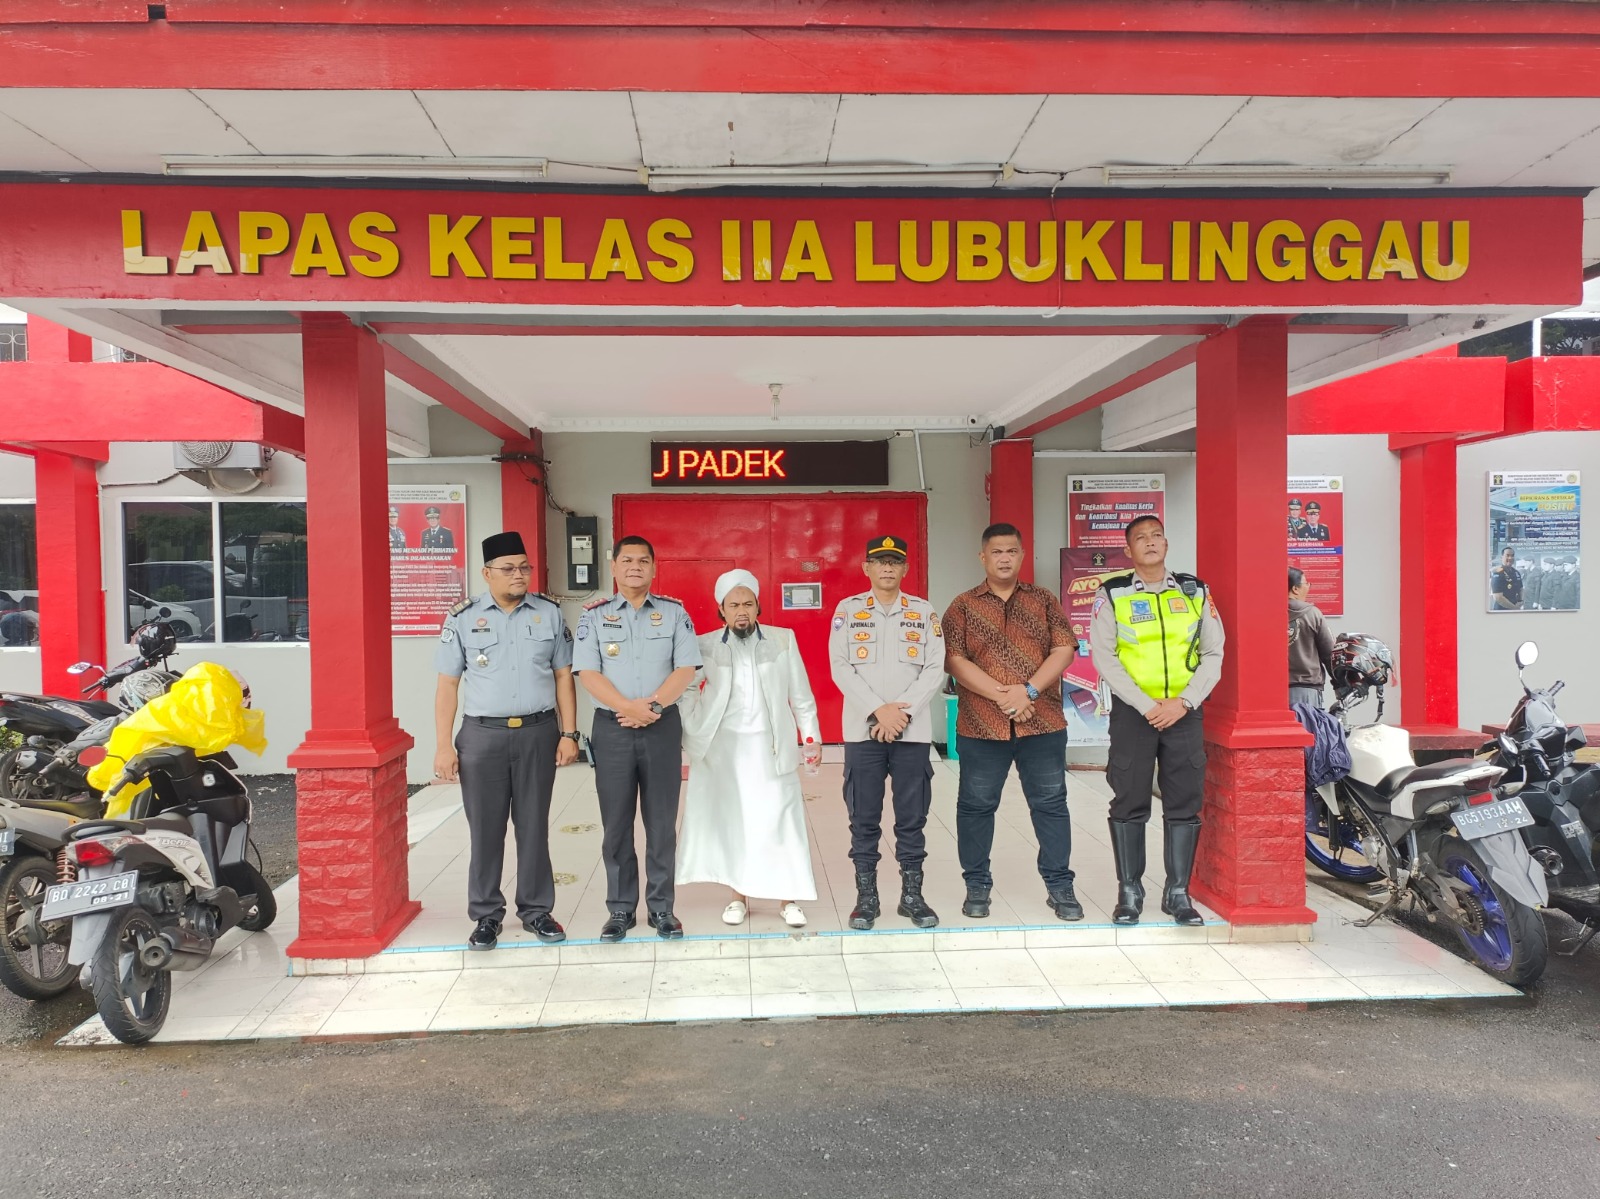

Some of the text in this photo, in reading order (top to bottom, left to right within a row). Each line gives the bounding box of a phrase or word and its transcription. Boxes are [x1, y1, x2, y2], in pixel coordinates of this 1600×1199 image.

[121, 209, 1471, 283] LAPAS KELAS IIA LUBUKLINGGAU
[653, 450, 786, 477] J PADEK
[1080, 503, 1113, 512] Tingkatkan
[1075, 513, 1086, 521] dan
[1070, 578, 1100, 592] AYO
[900, 621, 925, 629] POLRI
[51, 889, 69, 903] BD
[74, 883, 107, 899] 2242
